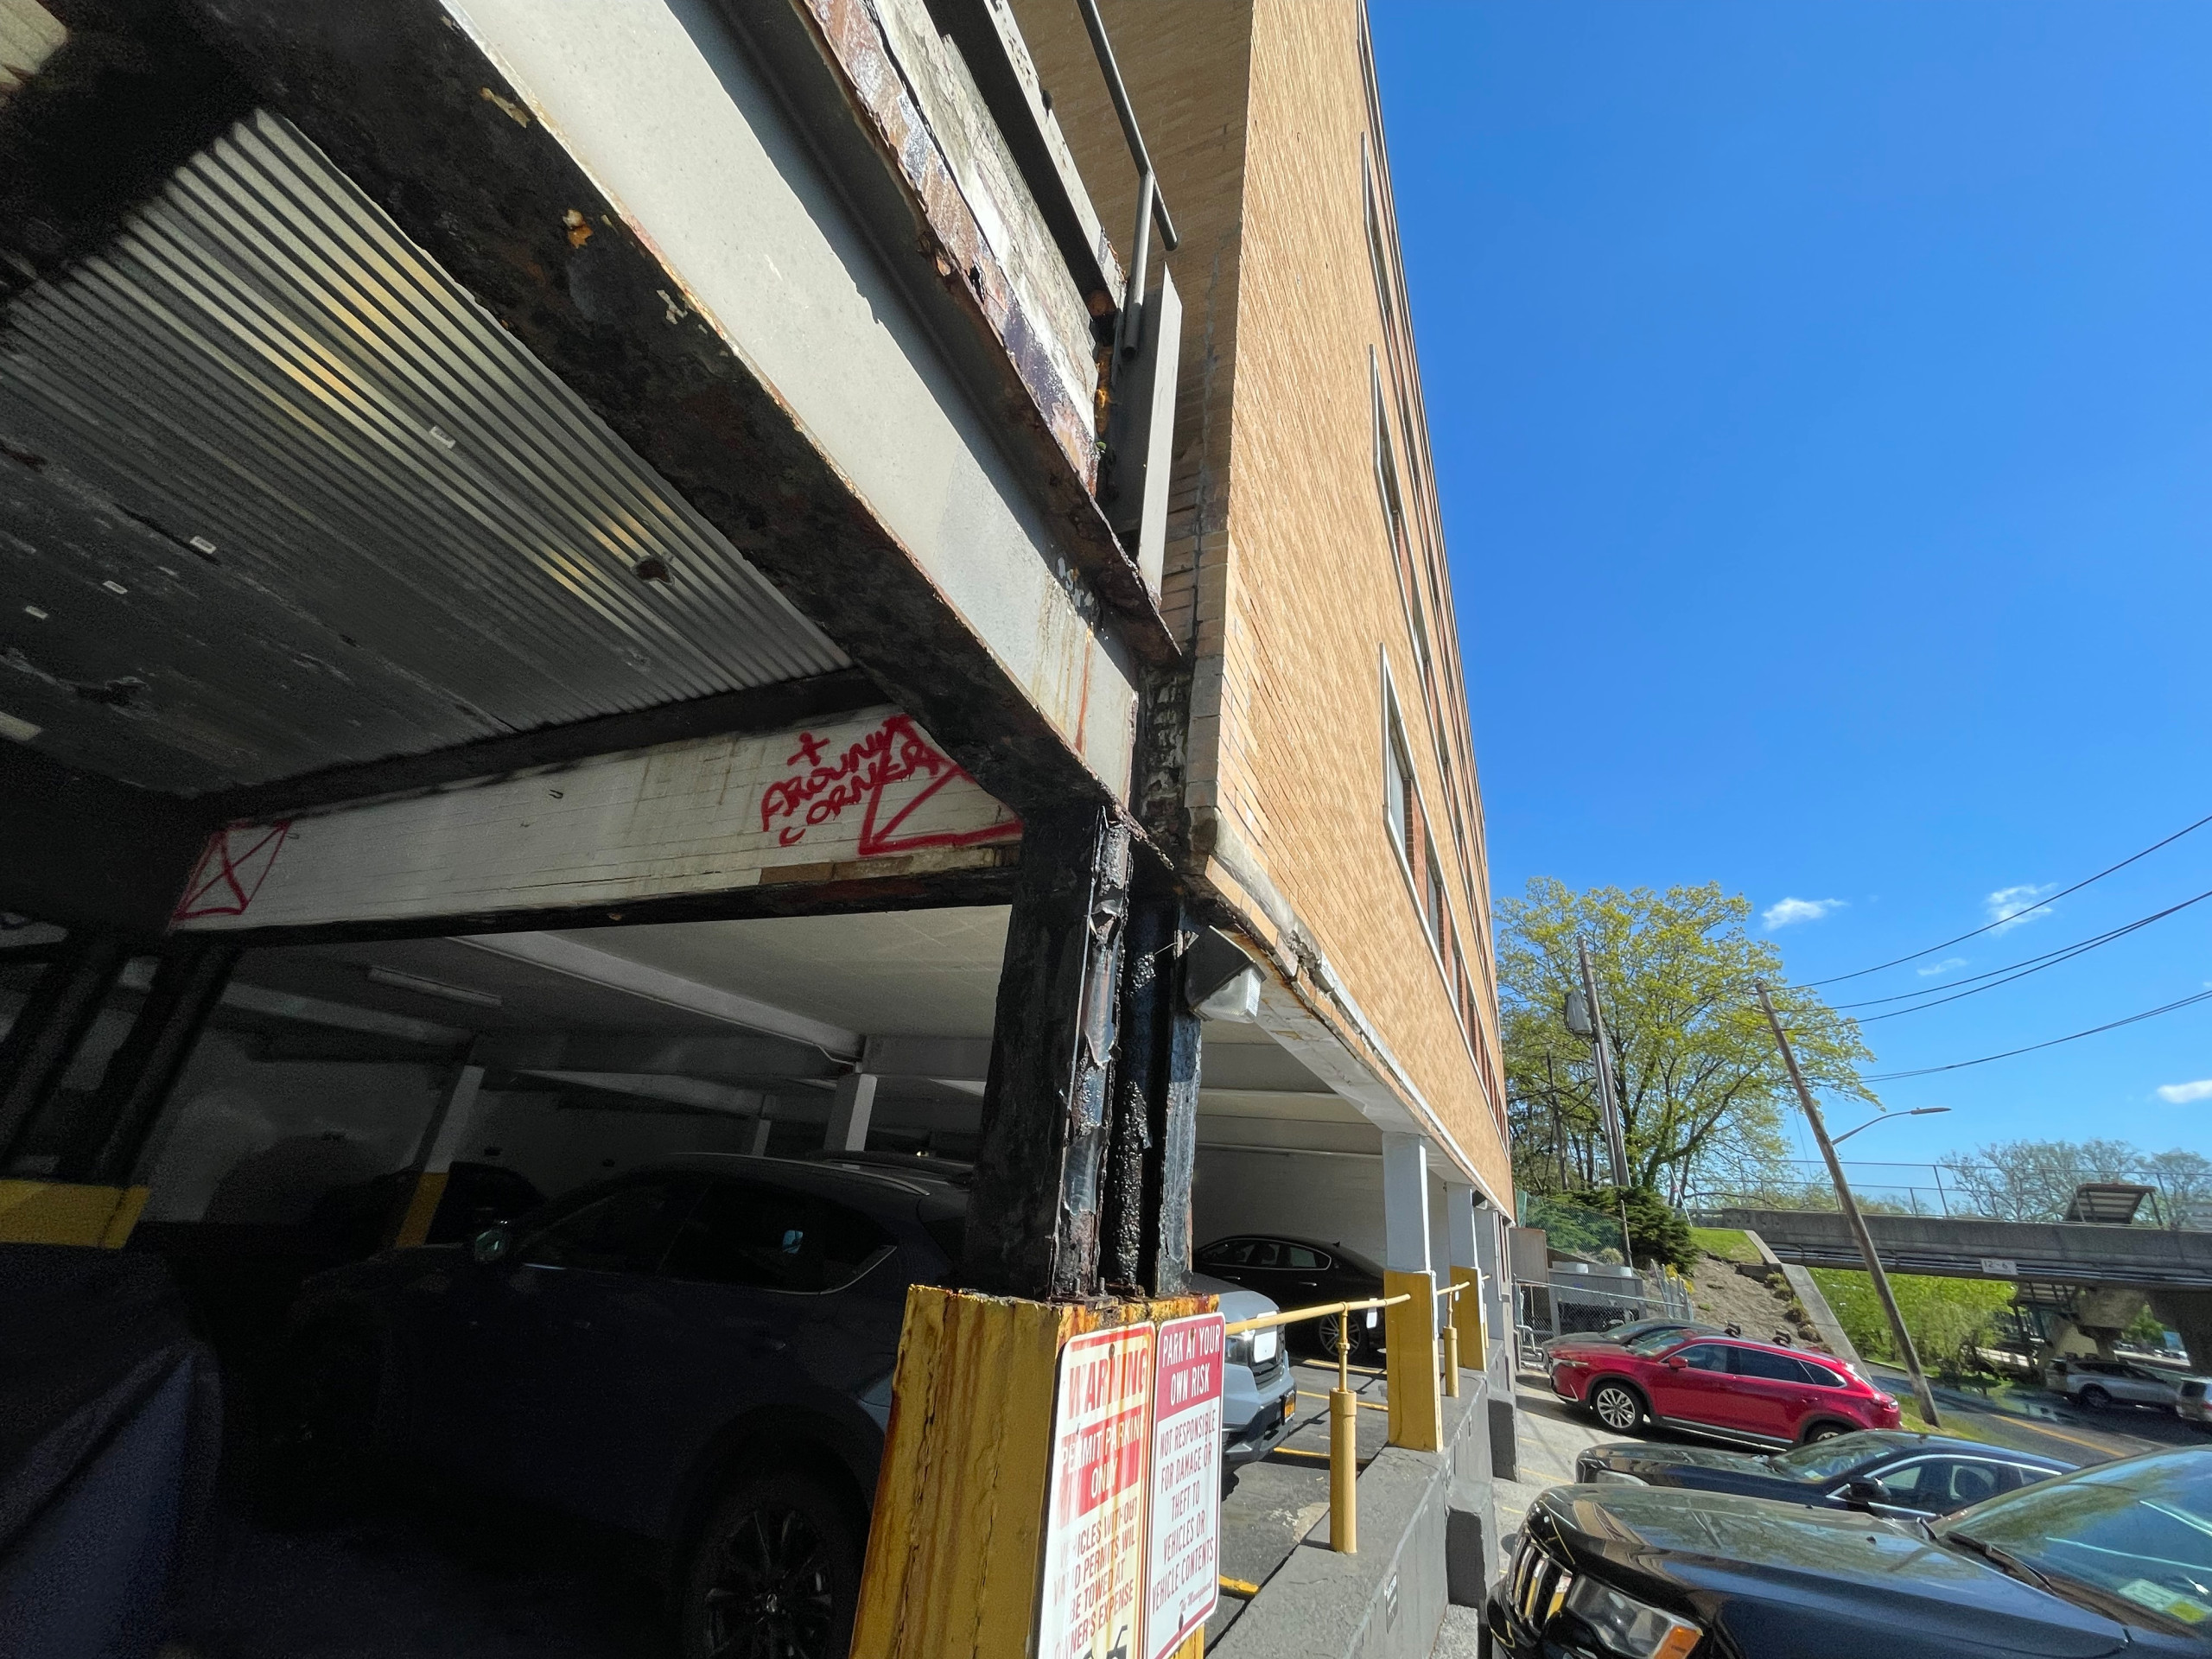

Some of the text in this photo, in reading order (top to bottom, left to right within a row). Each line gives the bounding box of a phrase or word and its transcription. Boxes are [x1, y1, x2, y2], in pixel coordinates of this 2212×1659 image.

[779, 741, 940, 847] CORNER
[1162, 1324, 1221, 1369] PARK AT YOUR
[1068, 1348, 1147, 1420] WARNING
[1170, 1363, 1211, 1406] OWN RISK
[1160, 1409, 1216, 1459] NOT RESPONSIBLE
[1090, 1457, 1118, 1499] ONLY
[1160, 1441, 1212, 1494] FOR DAMAGE OR
[1171, 1480, 1200, 1522] THEFT TO
[1164, 1510, 1205, 1565] VEHICLES OR
[1053, 1563, 1081, 1606] VAID
[1083, 1534, 1120, 1583] PERMITS
[1070, 1558, 1126, 1624] BE TOWED AT
[1152, 1536, 1215, 1615] VEHICLE CONTENTS
[1097, 1579, 1135, 1630] EXPENSE
